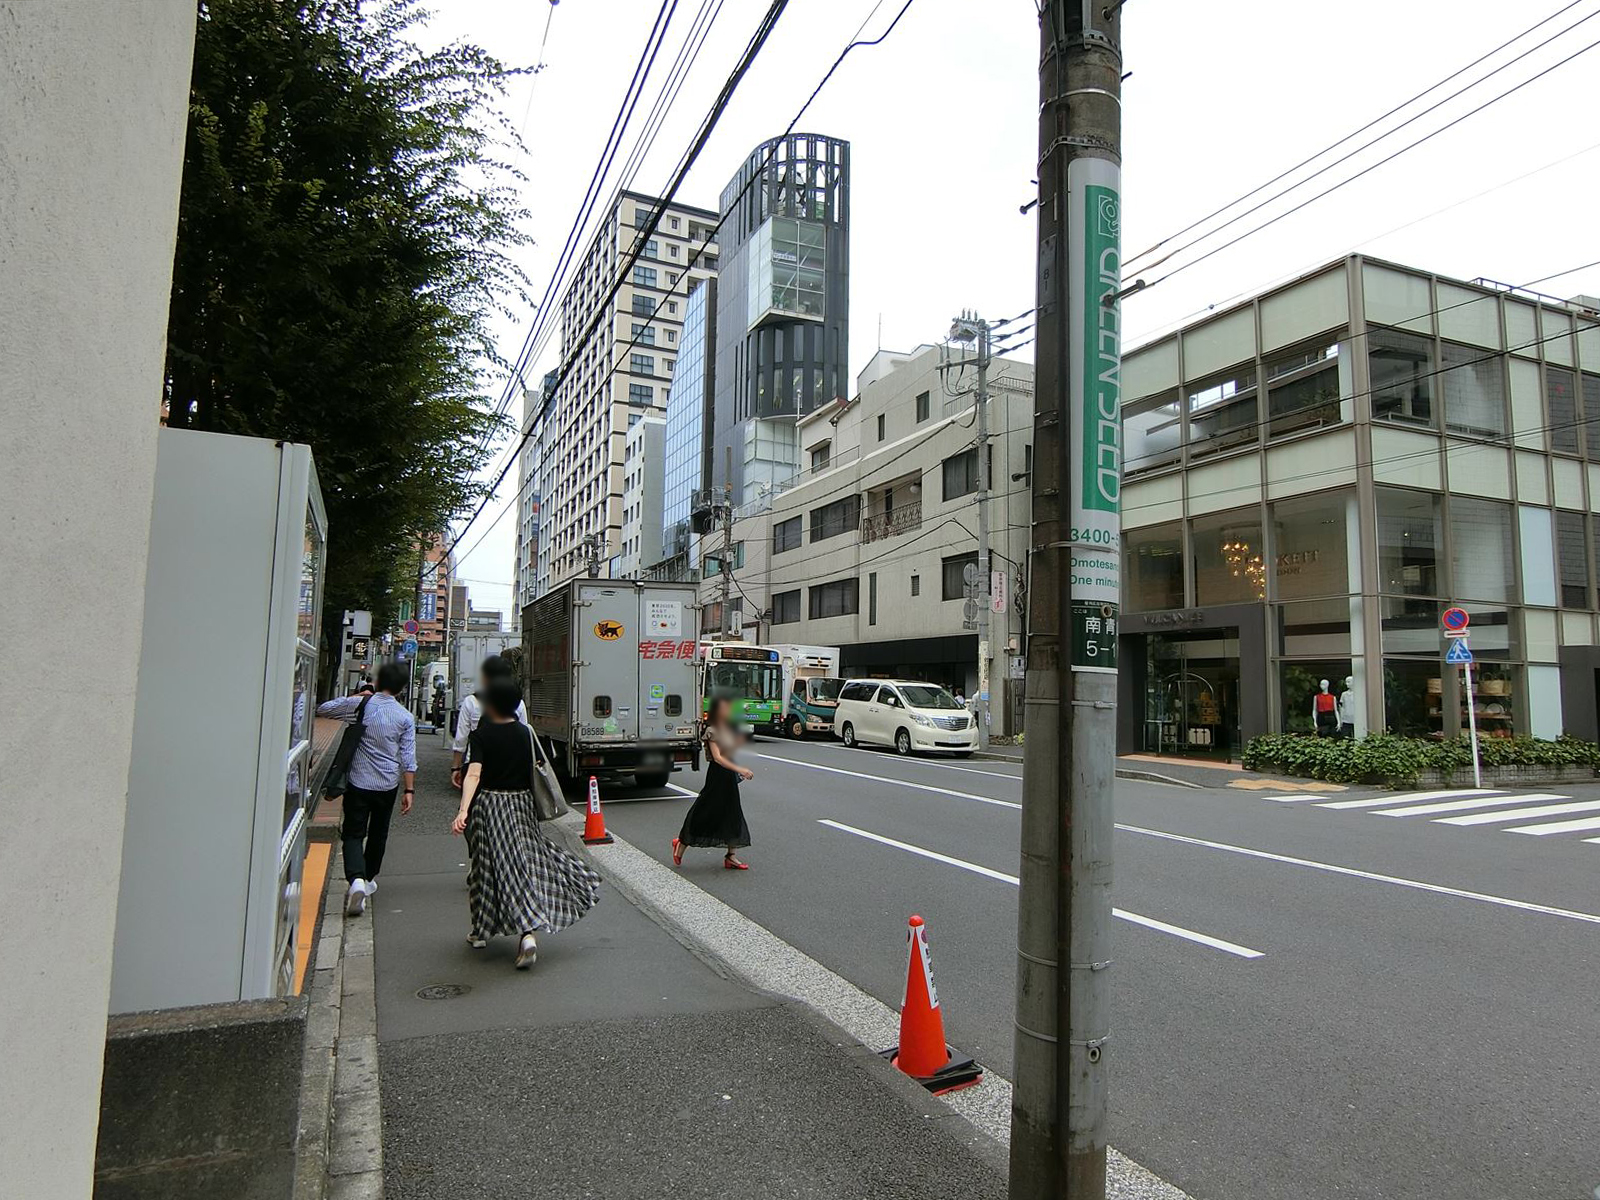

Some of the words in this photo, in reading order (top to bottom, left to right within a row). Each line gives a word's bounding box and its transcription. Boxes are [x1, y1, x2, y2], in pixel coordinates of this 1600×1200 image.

[1097, 393, 1120, 503] SEED
[1070, 557, 1119, 571] Omotesan
[1070, 574, 1093, 585] One
[1085, 616, 1119, 637] 南青
[638, 640, 696, 660] 宅急便
[581, 727, 605, 736] D8589
